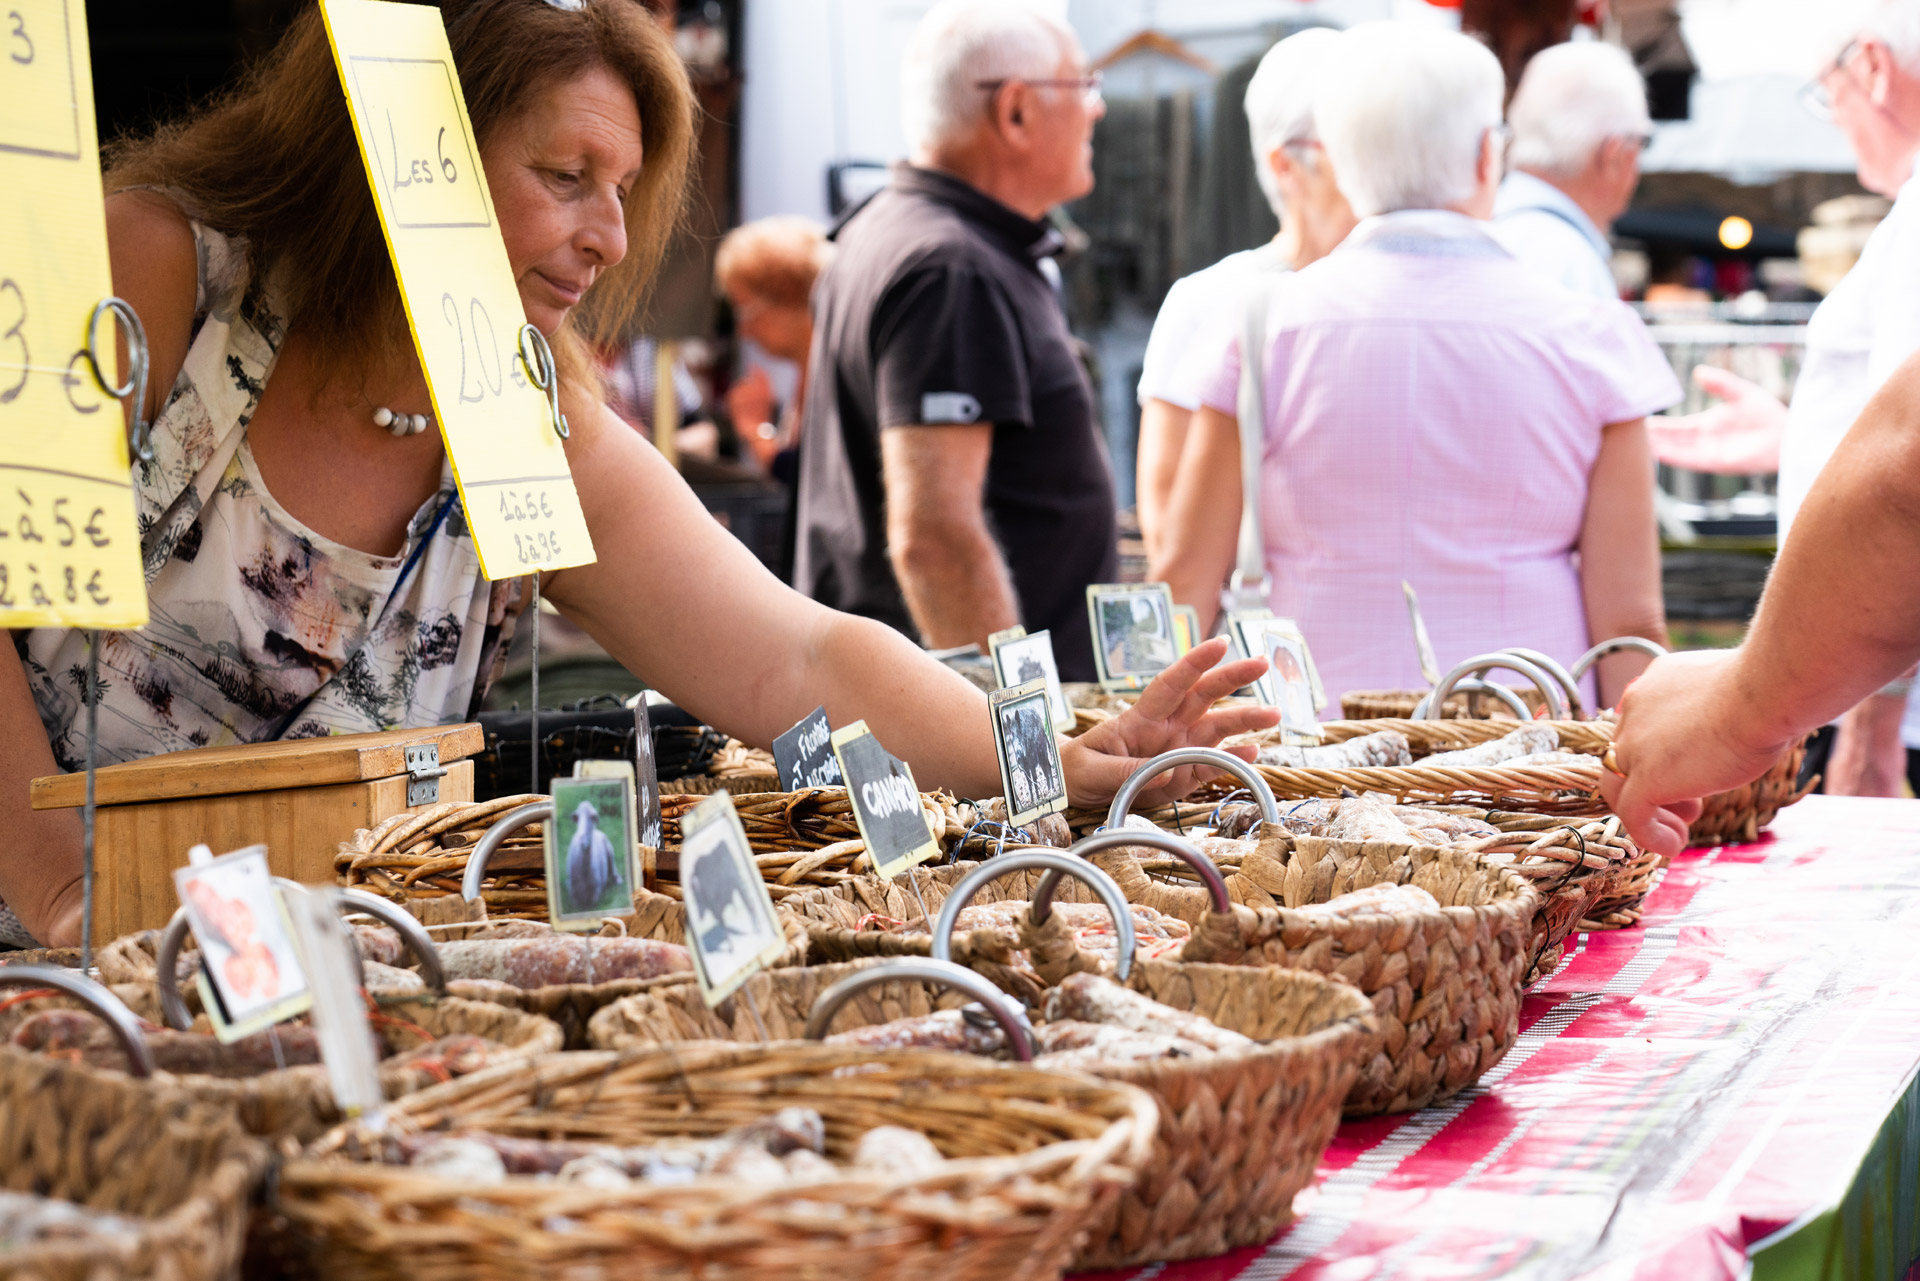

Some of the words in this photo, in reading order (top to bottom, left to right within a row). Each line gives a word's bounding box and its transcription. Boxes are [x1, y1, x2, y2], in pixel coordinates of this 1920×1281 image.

[8, 10, 35, 66] 3
[437, 125, 458, 184] 6
[861, 772, 920, 819] CANARD
